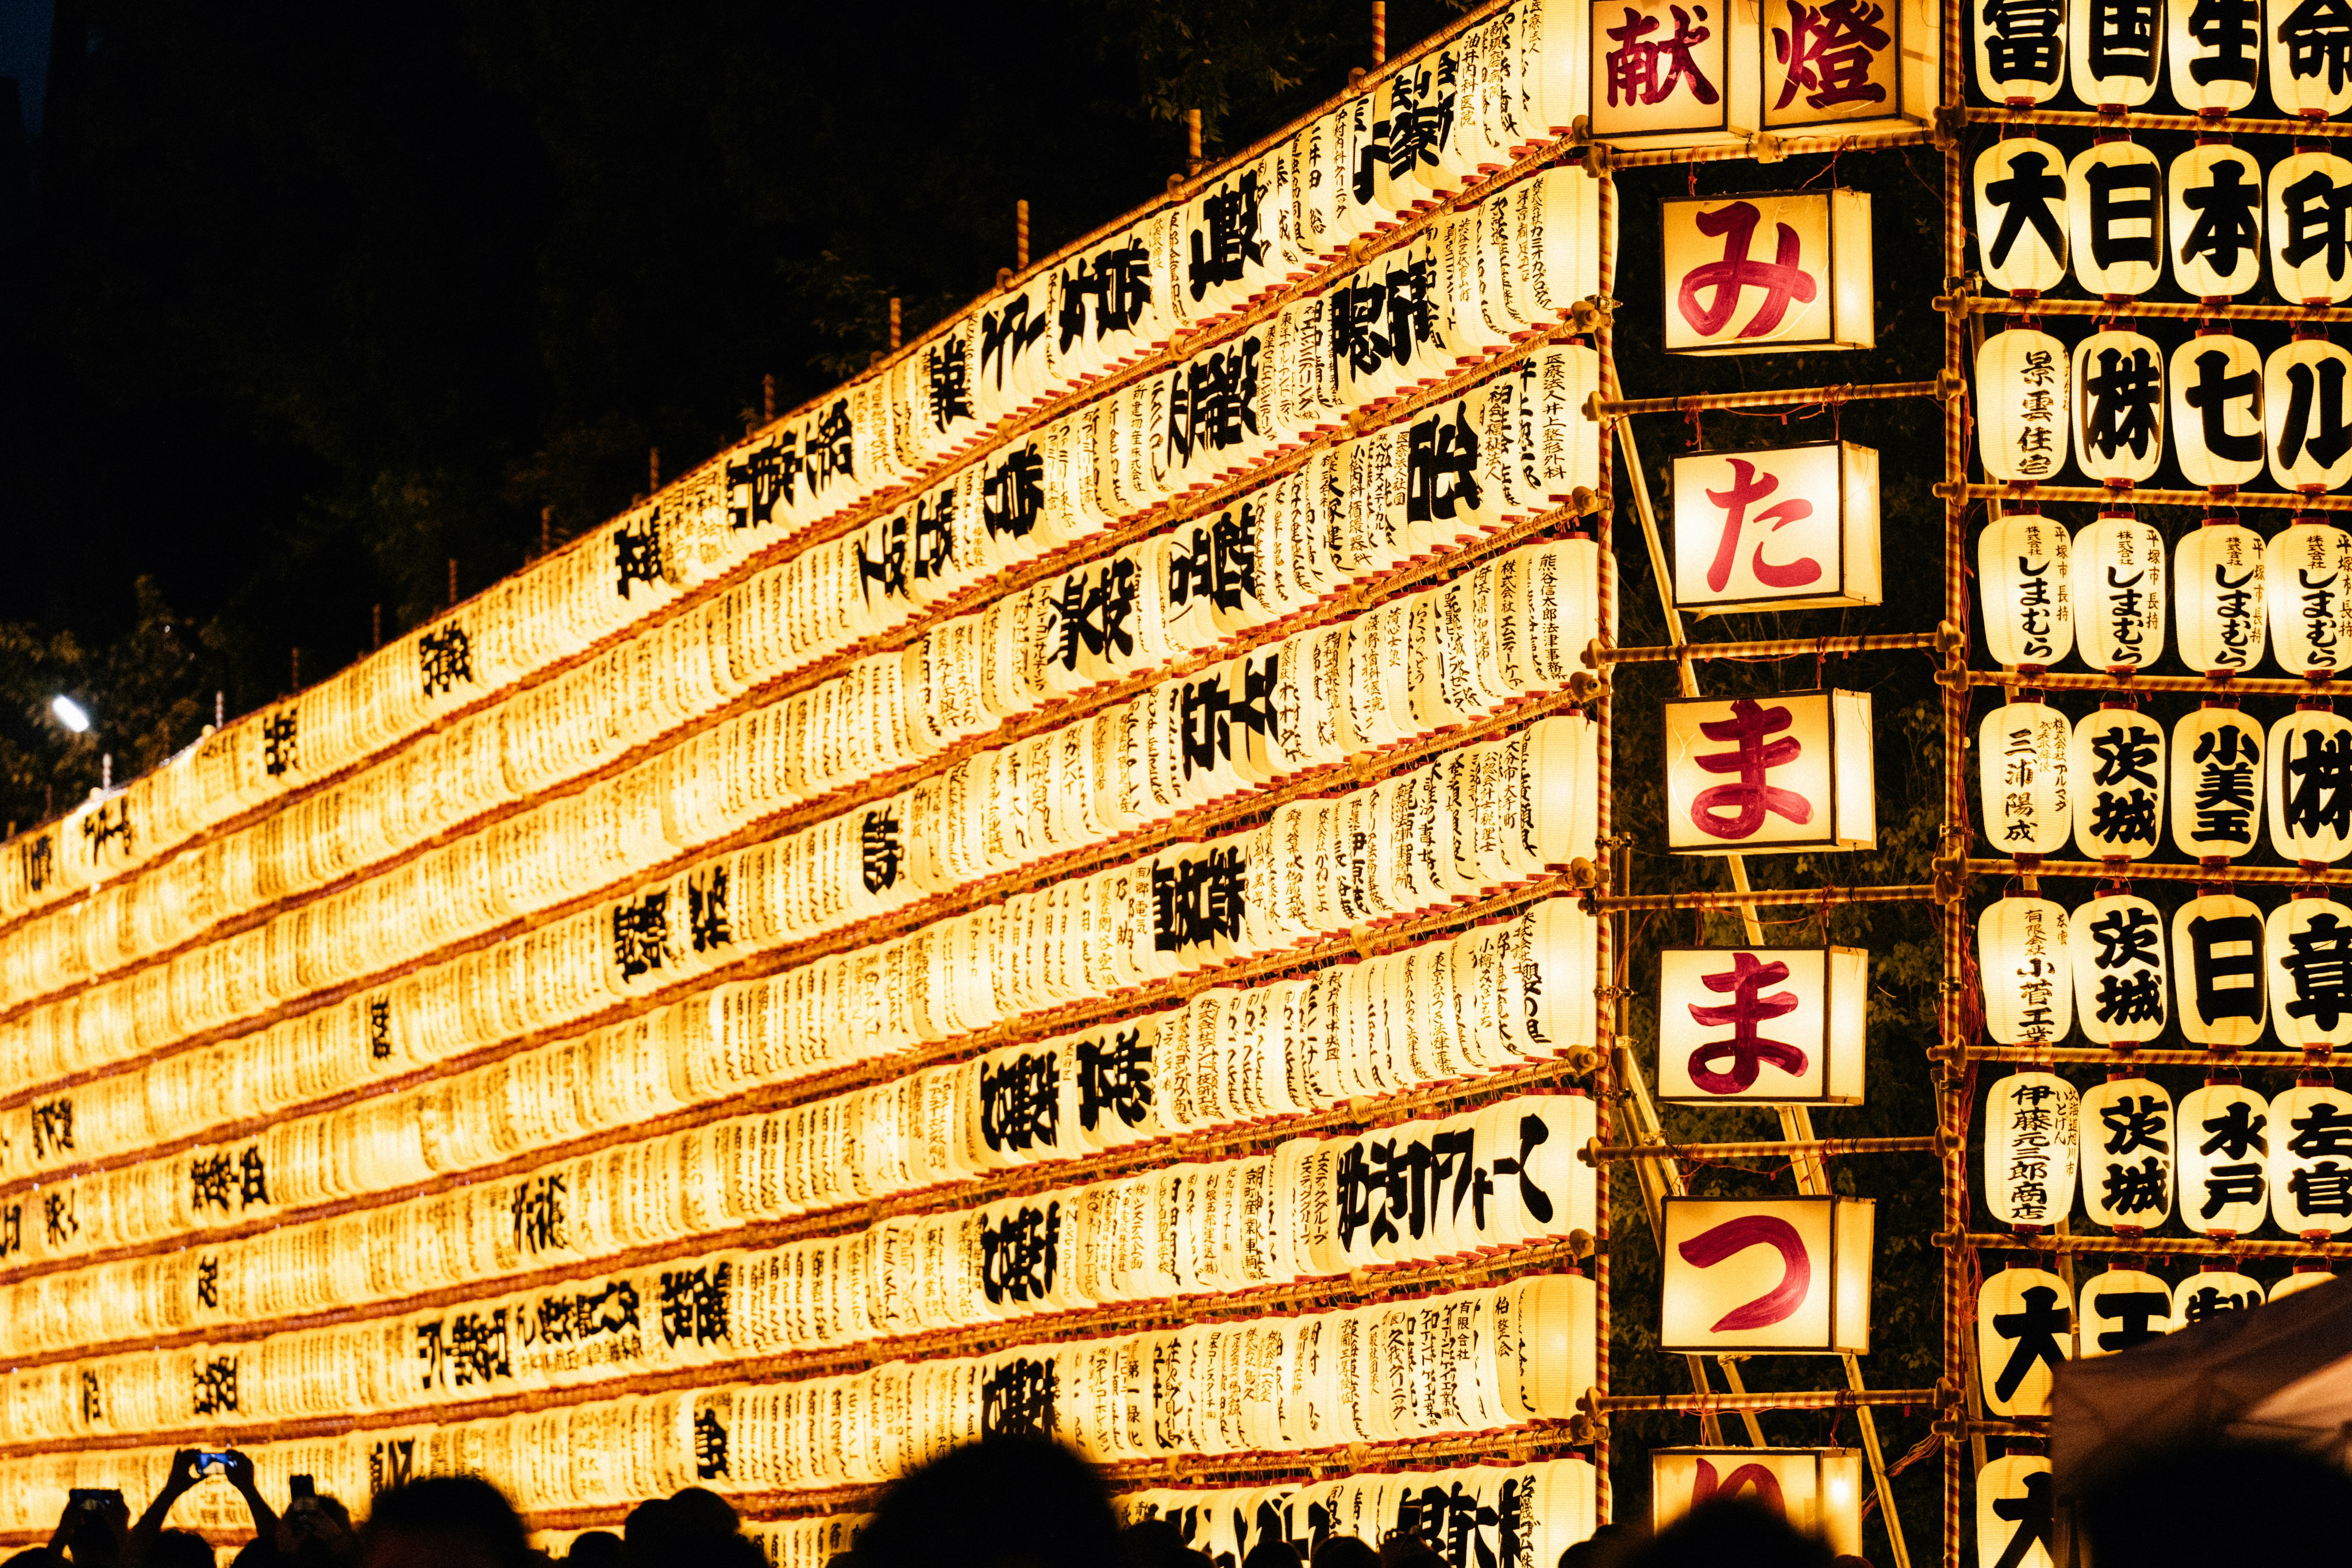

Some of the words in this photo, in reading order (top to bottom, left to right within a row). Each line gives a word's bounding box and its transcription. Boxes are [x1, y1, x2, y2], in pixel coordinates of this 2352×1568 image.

[1606, 4, 1720, 107] 献
[1772, 0, 1891, 110] 燈
[1983, 0, 2066, 84] 富
[2088, 0, 2163, 86] 国
[2189, 0, 2259, 90] 生
[2278, 0, 2352, 95] 命
[1985, 151, 2066, 270] 大
[2085, 161, 2162, 271] 日
[2181, 159, 2261, 278] 本
[1677, 201, 1817, 338] み
[1542, 353, 1566, 480] 医療法人井上整形外科
[2016, 350, 2055, 476] 景雲住宅
[2185, 350, 2263, 461] セ
[2276, 357, 2352, 470] ル
[1711, 459, 1820, 592] た
[2025, 526, 2042, 556] 株式会社
[2055, 526, 2069, 580] 平塚市
[2116, 530, 2134, 566] 株式会社
[2146, 529, 2160, 587] 平塚市
[2226, 535, 2243, 567] 株式会社
[2252, 537, 2265, 599] 平塚市
[2305, 534, 2327, 569] 株式会社
[2336, 533, 2352, 596] 平塚市
[1538, 553, 1568, 680] 熊谷信太郎法律事務所
[2019, 556, 2053, 658] しまむら
[2056, 584, 2069, 622] 長持
[2107, 566, 2144, 664] しまむら
[2146, 592, 2159, 630] 長持
[2214, 564, 2255, 668] しまむら
[2249, 607, 2264, 644] 長持
[2299, 568, 2339, 668] しまむら
[2339, 599, 2352, 638] 長持
[1503, 741, 1520, 829] 大分市大手町
[1692, 698, 1811, 841] ま
[2003, 728, 2038, 843] 三浦陽成
[2089, 726, 2160, 846] 茨城
[2191, 725, 2260, 845] 小美玉
[2024, 908, 2047, 957] 有限会社
[2090, 907, 2163, 1026] 茨城
[2187, 915, 2266, 1027] 日
[2280, 913, 2352, 1033] 章
[1688, 949, 1811, 1095] ま
[2016, 958, 2055, 1042] 小菅工業
[2007, 1084, 2055, 1220] 伊藤元三郎商店
[2100, 1095, 2170, 1215] 茨城
[2199, 1101, 2269, 1219] 水戸
[2288, 1103, 2352, 1218] 左官
[1677, 1212, 1814, 1332] つ
[1456, 1300, 1474, 1361] 有限会社
[1495, 1296, 1514, 1358] 柏整会
[1993, 1285, 2072, 1403] 大
